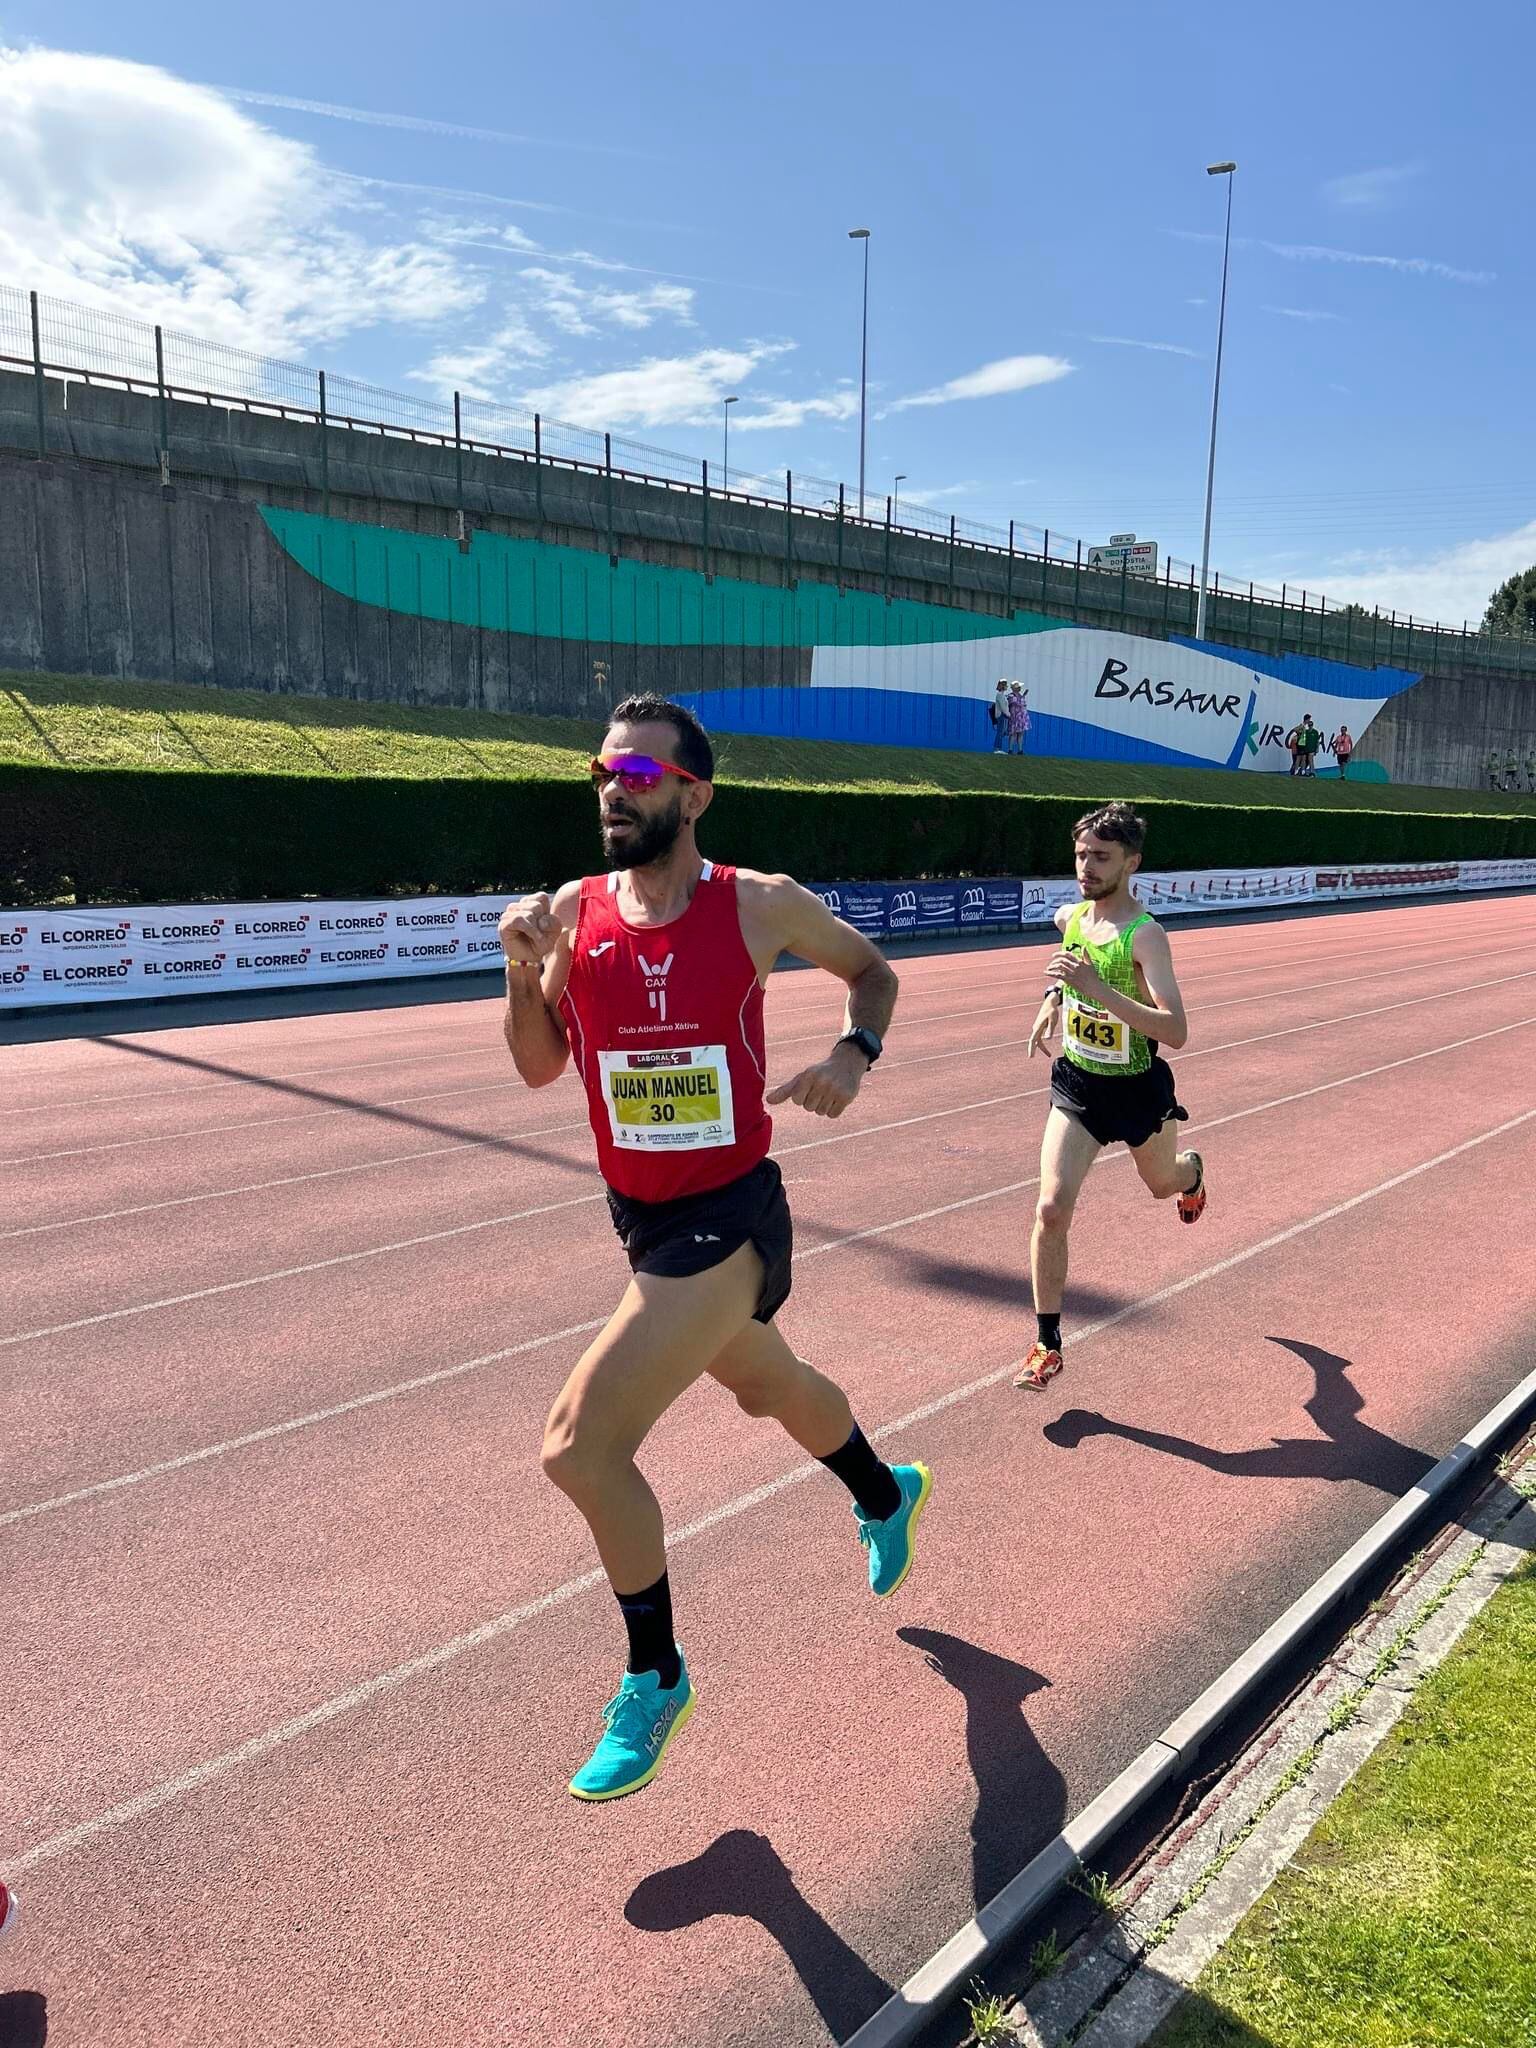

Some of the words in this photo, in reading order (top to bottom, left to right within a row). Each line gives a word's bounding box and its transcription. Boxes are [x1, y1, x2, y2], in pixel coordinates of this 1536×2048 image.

[319, 919, 335, 930] EL
[335, 917, 385, 930] CORREO
[396, 916, 410, 927] EL
[411, 914, 456, 926] CORREO
[466, 913, 479, 923] EL
[142, 928, 160, 939] EL
[162, 924, 221, 938] CORREO
[235, 923, 250, 934] EL
[253, 920, 306, 934] CORREO
[41, 932, 60, 944] EL
[63, 929, 126, 942] CORREO
[397, 947, 411, 958] EL
[412, 944, 456, 957] CORREO
[467, 942, 480, 953] EL
[237, 957, 252, 968] EL
[254, 954, 307, 967] CORREO
[320, 952, 336, 963] EL
[337, 949, 385, 961] CORREO
[43, 969, 62, 981] EL
[64, 965, 128, 980] CORREO
[144, 963, 162, 975] EL
[164, 959, 222, 973] CORREO
[645, 977, 667, 988] CAX
[618, 1026, 637, 1034] Club
[1072, 1015, 1115, 1047] 143
[637, 1054, 671, 1063] LABORAL
[613, 1077, 648, 1099] JUAN
[651, 1073, 717, 1099] MANUEL
[650, 1103, 675, 1123] 30
[644, 1696, 678, 1759] HOKA
